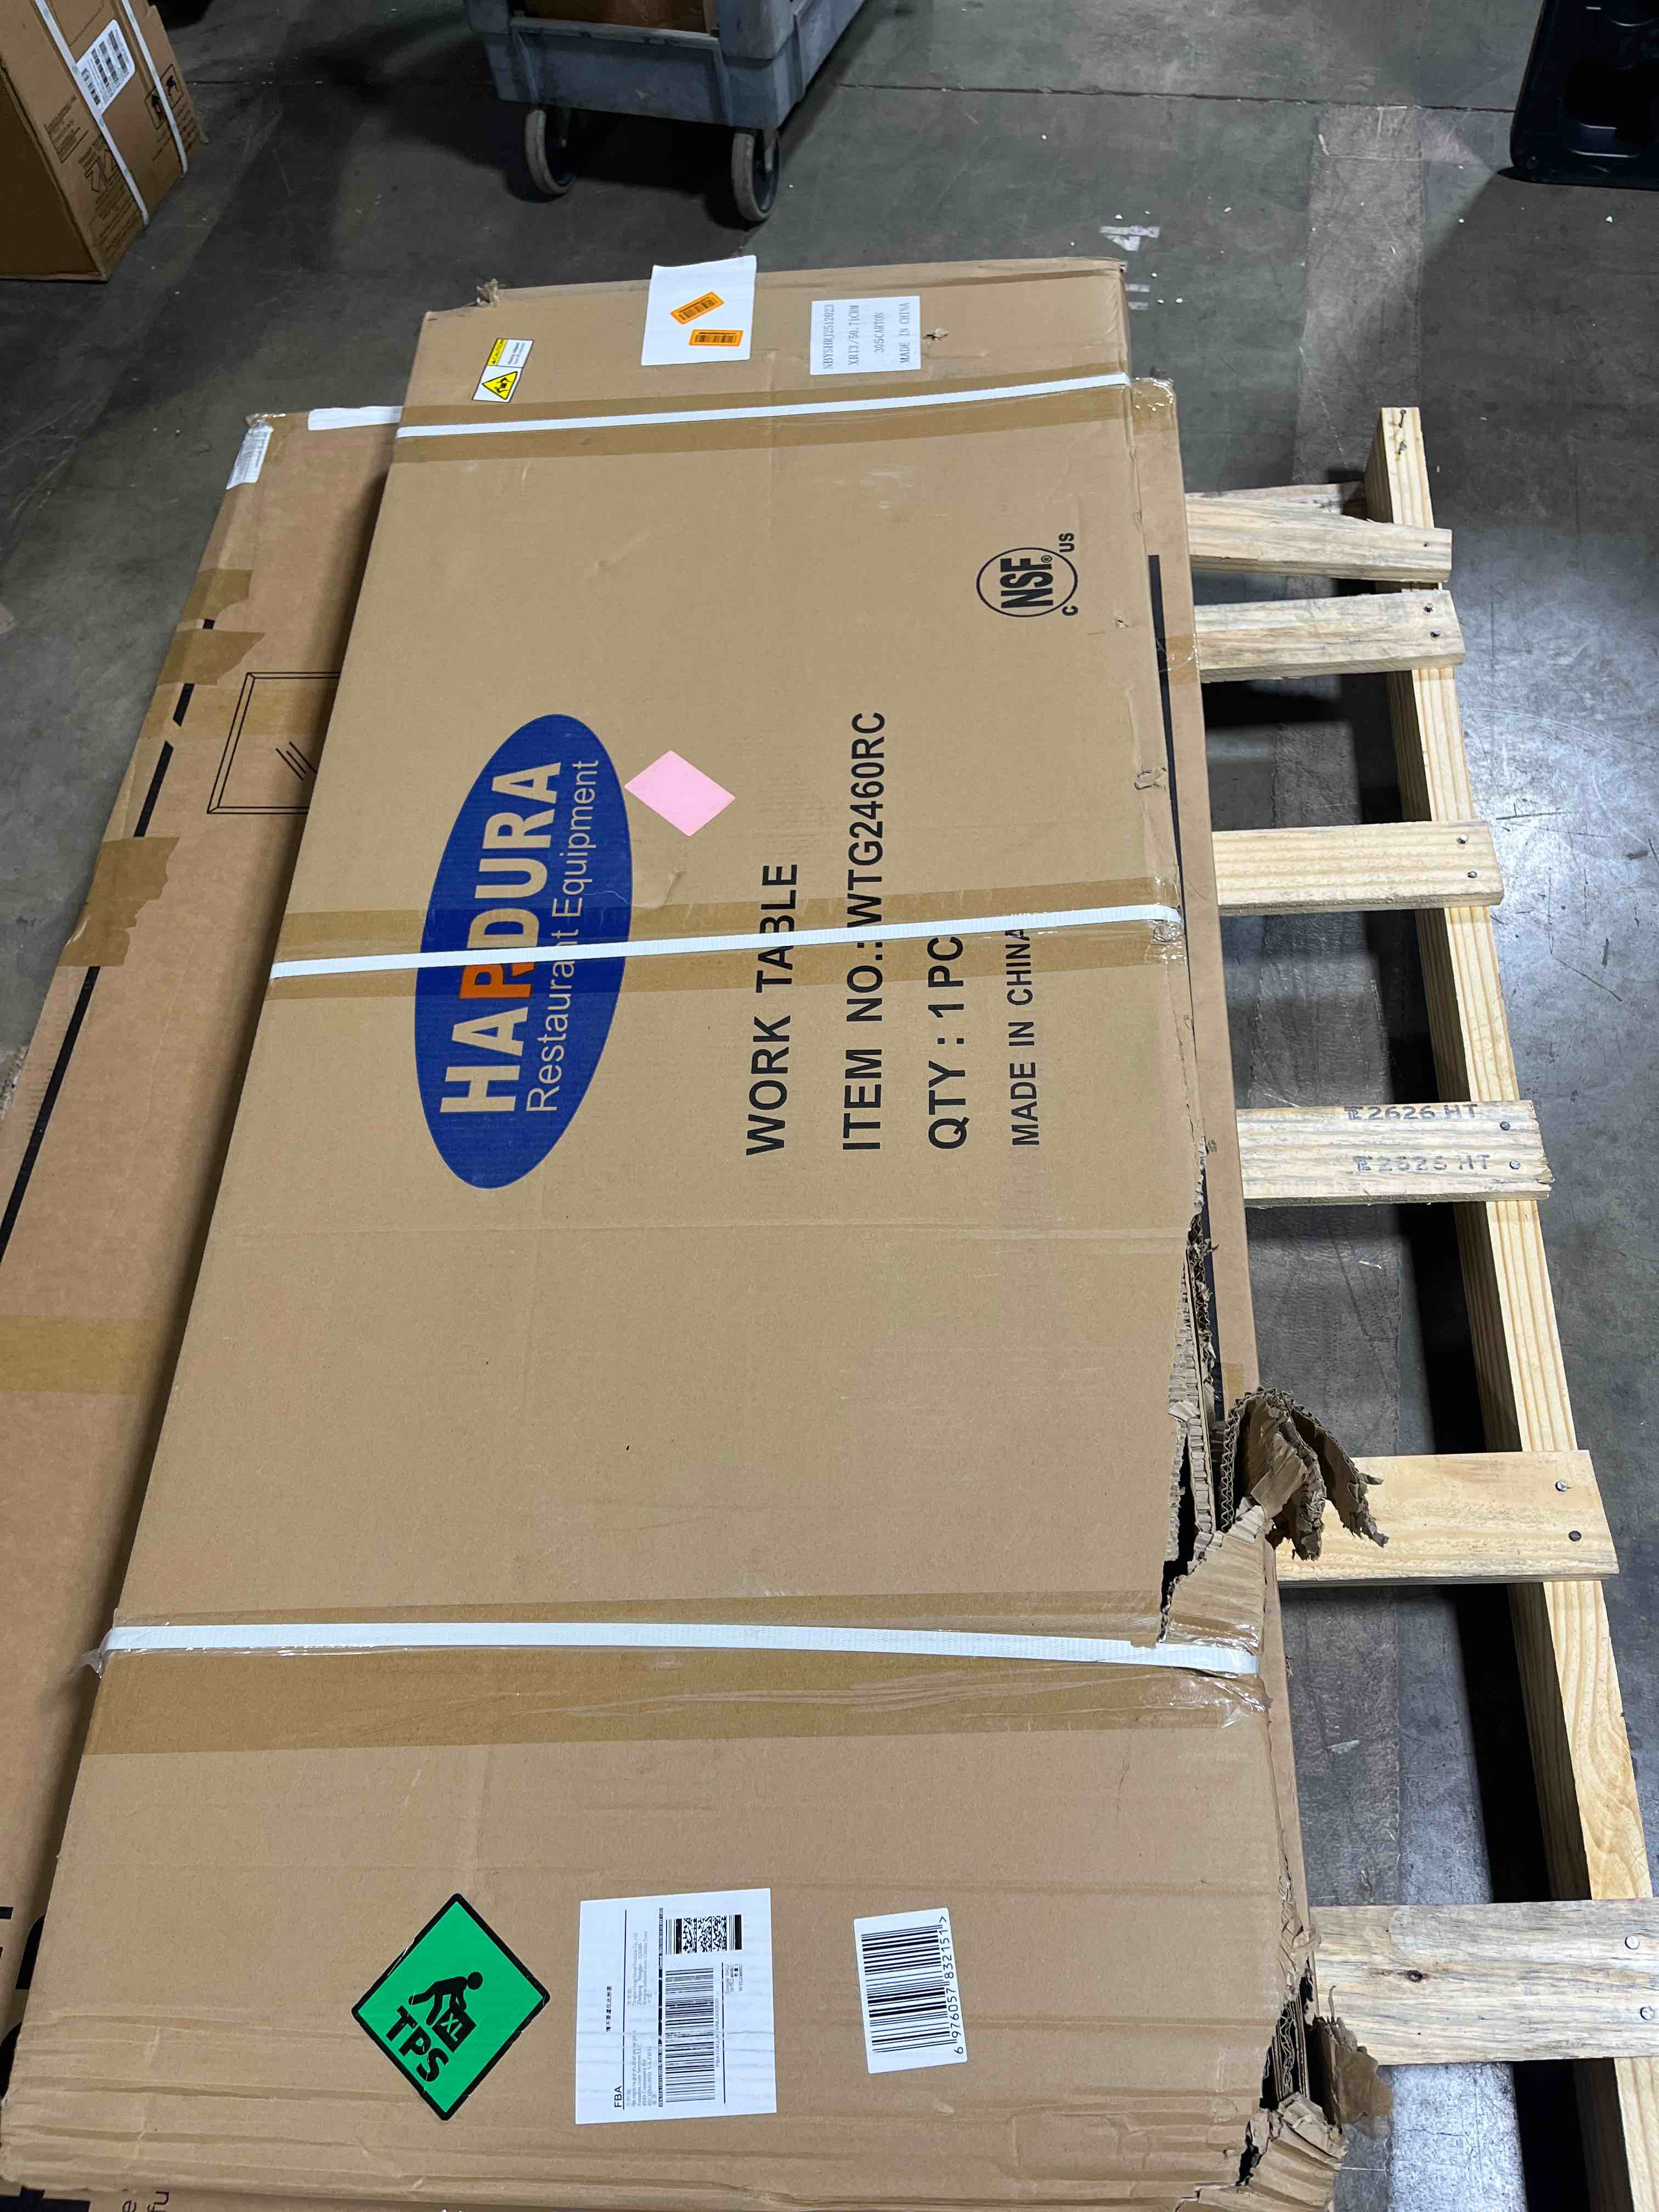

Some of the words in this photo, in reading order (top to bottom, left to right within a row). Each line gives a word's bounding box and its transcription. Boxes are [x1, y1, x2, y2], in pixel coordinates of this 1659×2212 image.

[899, 302, 910, 325] CHINA
[899, 328, 910, 336] IN
[899, 343, 911, 363] MADE
[1058, 533, 1075, 552] US
[1000, 558, 1053, 608] NSF
[551, 759, 599, 917] Equipment
[847, 712, 885, 928] WTG2460RC
[440, 761, 561, 1113] HARDURA
[755, 864, 797, 993] TABLE
[1008, 1022, 1035, 1046] IN
[746, 1015, 791, 1156] WORK
[843, 1048, 882, 1150] ITEM
[928, 1060, 970, 1149] QTY
[1008, 1062, 1040, 1146] MADE
[385, 2005, 449, 2083] TPS
[946, 1988, 961, 2038] 976057
[614, 2086, 622, 2108] FBA
